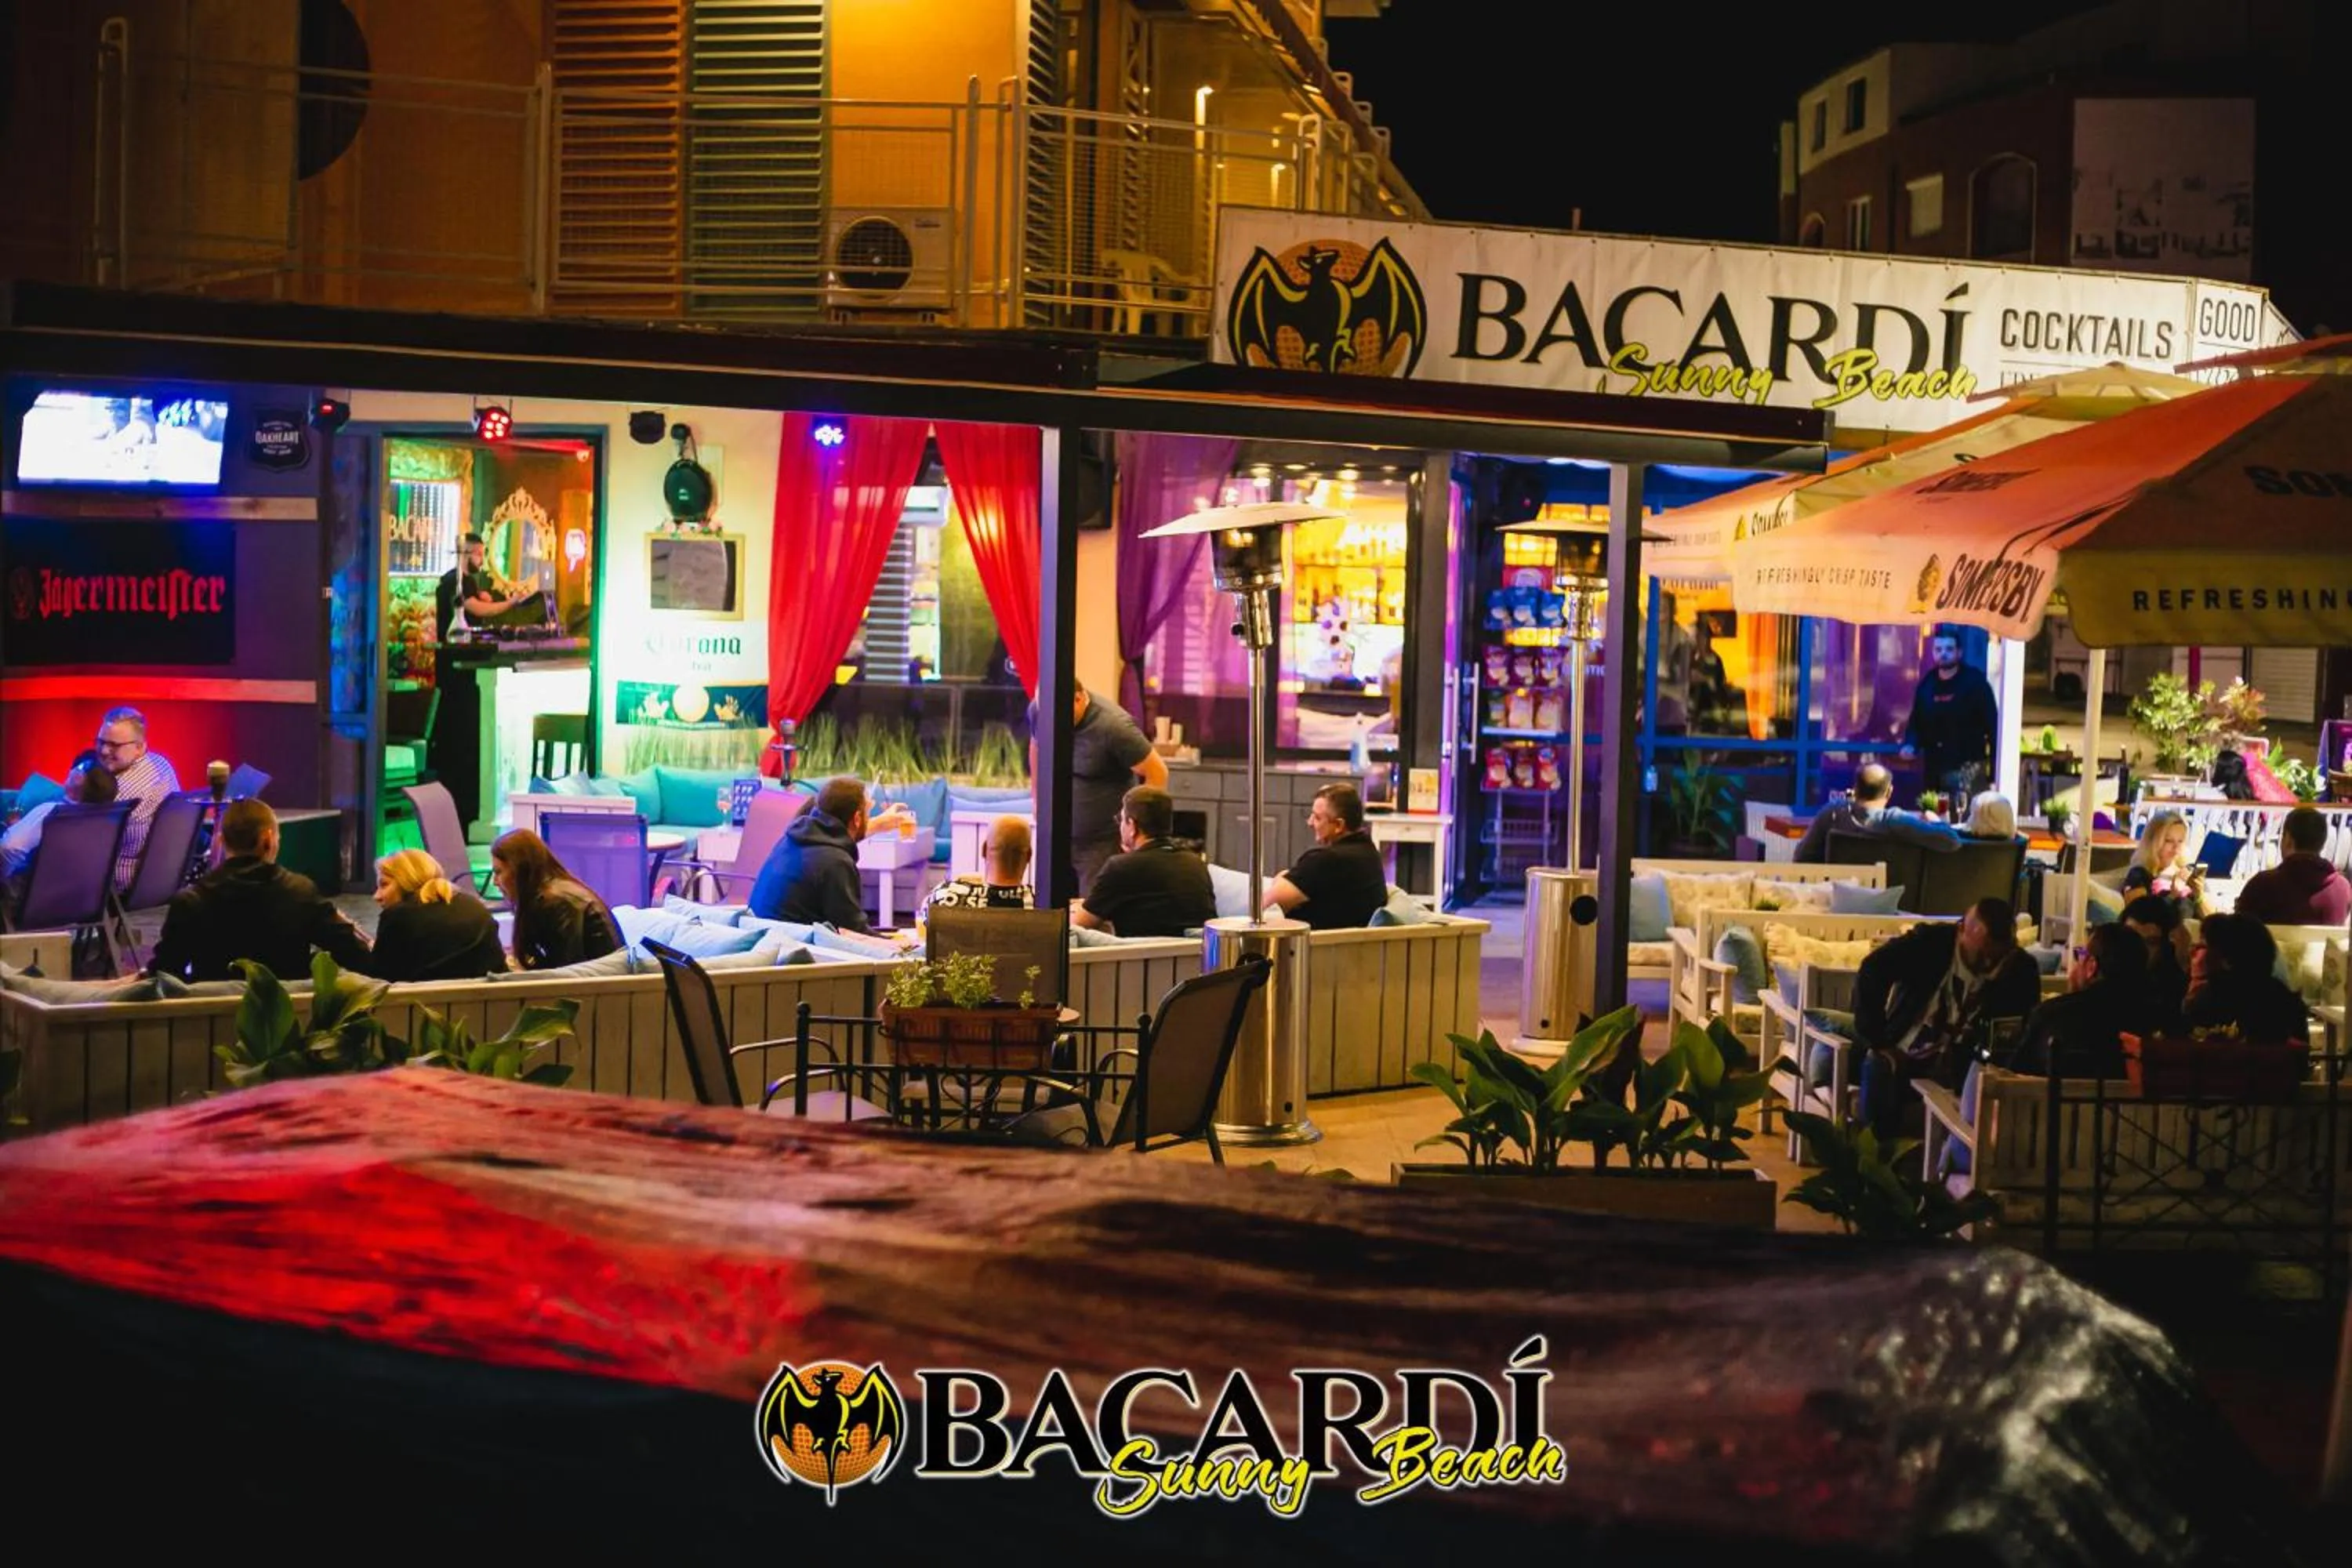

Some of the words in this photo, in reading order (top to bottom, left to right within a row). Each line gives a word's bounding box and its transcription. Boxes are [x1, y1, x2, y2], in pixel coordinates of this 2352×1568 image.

[1450, 272, 1972, 386] BACARDÍ
[2000, 308, 2174, 359] COCKTAILS
[2199, 297, 2256, 343] GOOD
[1596, 342, 1774, 406] Sunny
[1812, 347, 1977, 409] Beach
